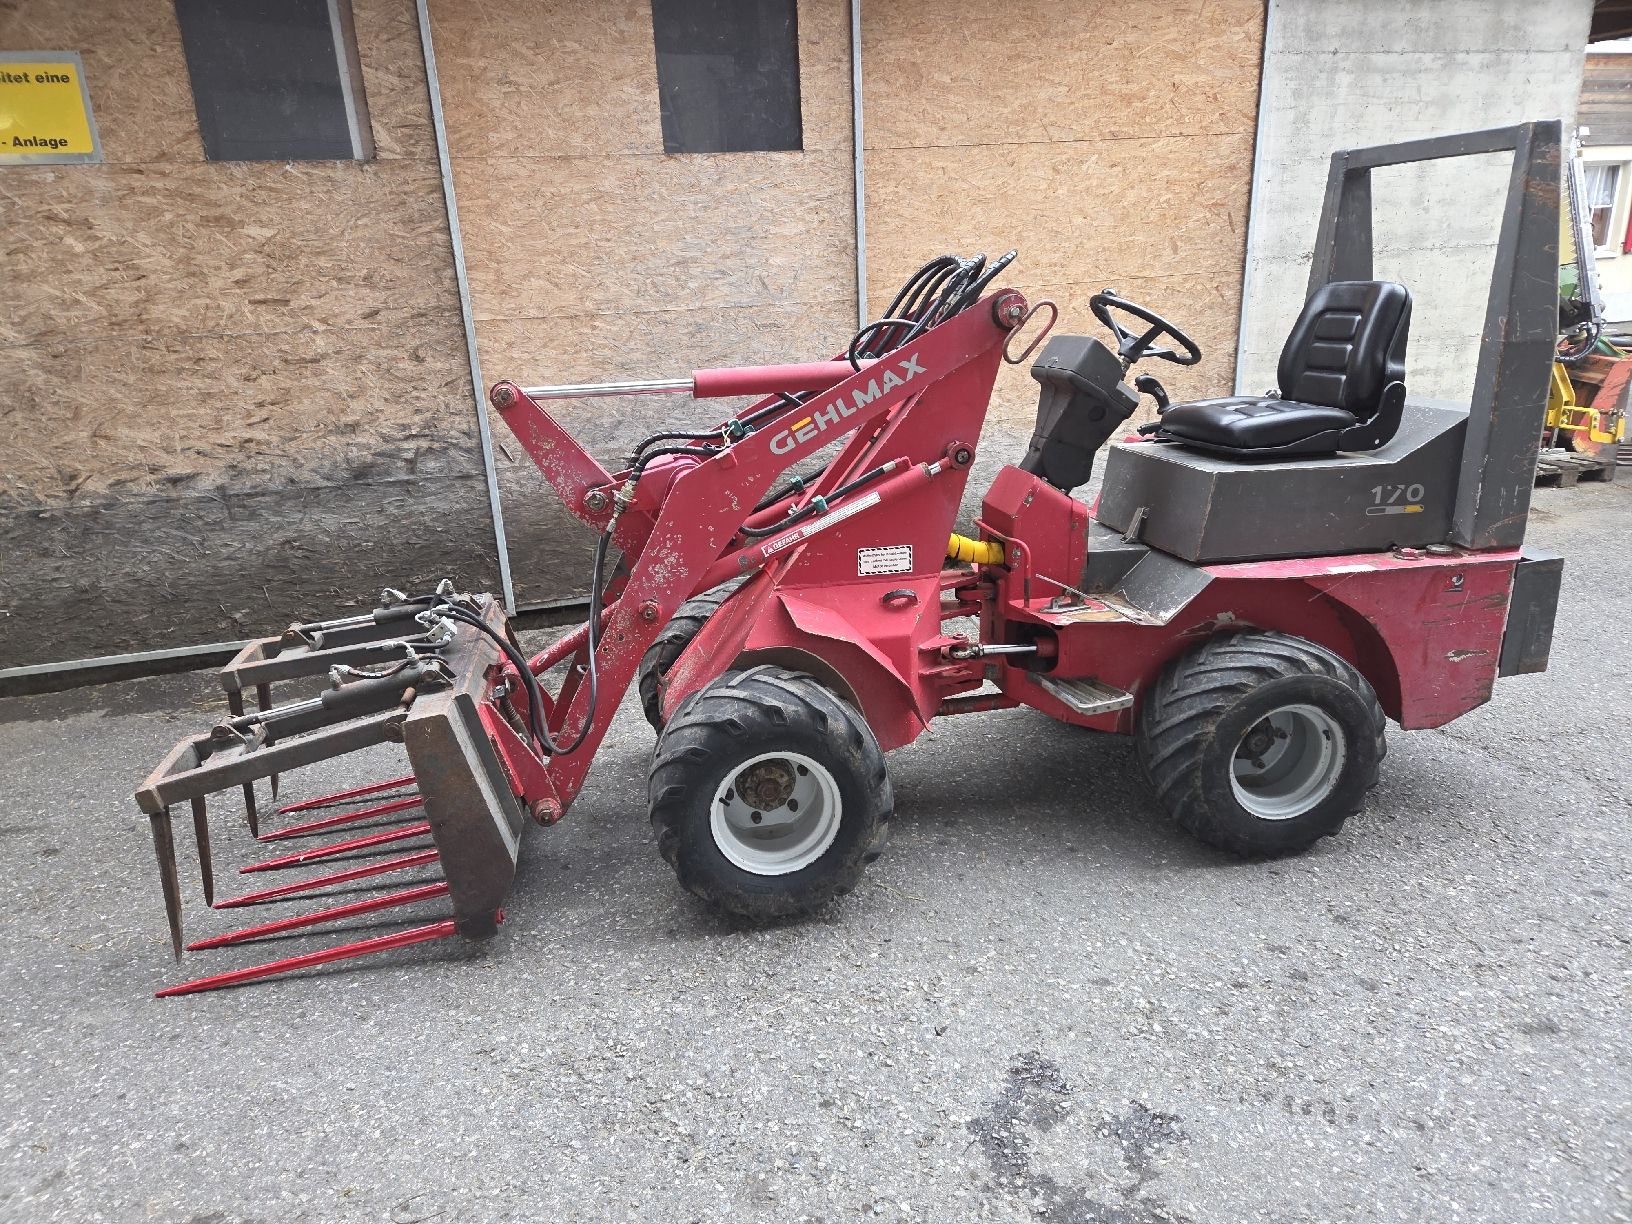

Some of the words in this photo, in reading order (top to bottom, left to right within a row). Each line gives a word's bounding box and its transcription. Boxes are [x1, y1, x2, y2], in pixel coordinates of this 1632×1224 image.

[0, 71, 30, 83] itet
[35, 71, 70, 83] eine
[12, 136, 68, 149] Anlage
[769, 352, 927, 455] GEHLMAX
[1371, 484, 1425, 504] 170
[773, 531, 801, 550] GEFAHR
